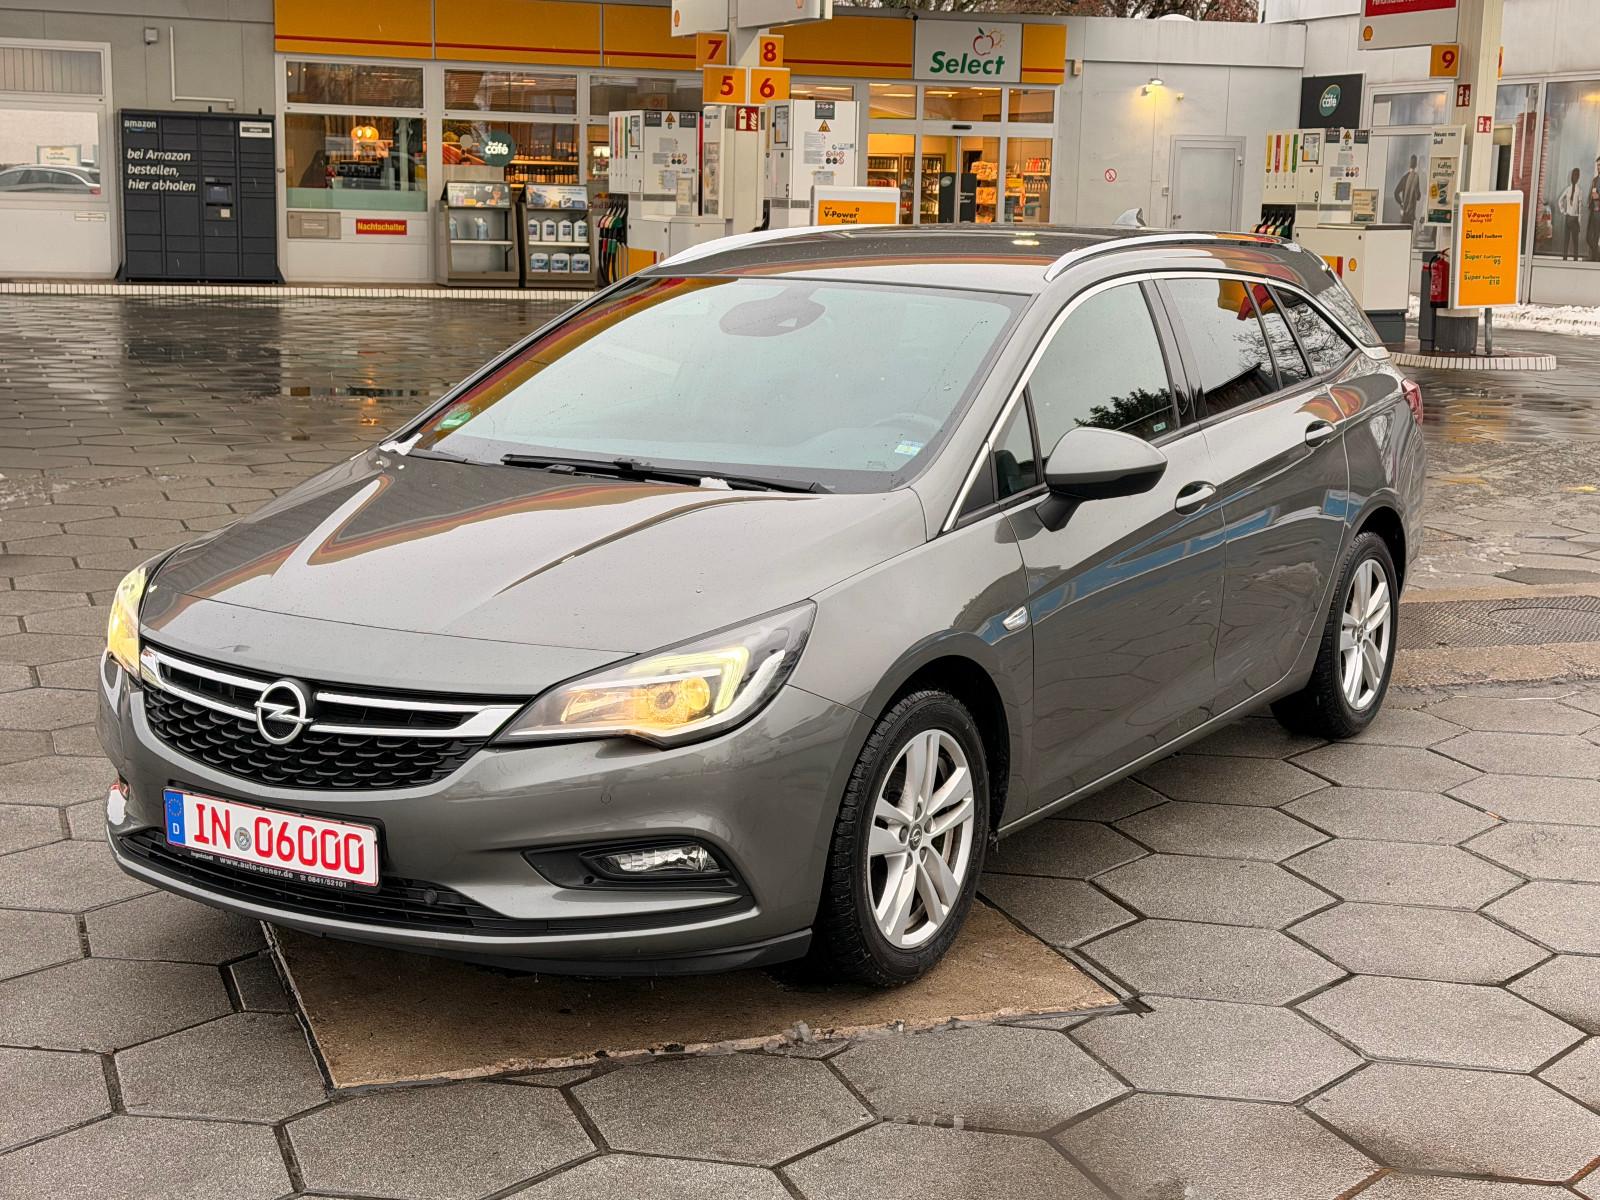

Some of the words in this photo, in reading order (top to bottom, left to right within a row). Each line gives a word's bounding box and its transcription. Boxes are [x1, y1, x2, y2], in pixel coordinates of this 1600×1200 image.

[707, 40, 723, 60] 7
[763, 42, 777, 62] 8
[929, 51, 1005, 75] Select
[1441, 50, 1455, 69] 9
[720, 76, 734, 96] 5
[760, 78, 775, 98] 6
[124, 119, 157, 129] amazon
[127, 148, 144, 160] bei
[146, 149, 191, 161] Amazon
[485, 143, 508, 154] café
[128, 164, 180, 177] bestellen,
[128, 179, 149, 190] hier
[152, 180, 196, 192] abholen
[824, 210, 858, 218] V-Power
[1467, 211, 1493, 219] V-Power
[357, 222, 406, 232] Nachtschalter
[172, 822, 180, 835] D
[194, 803, 231, 850] IN
[254, 816, 365, 875] 06000
